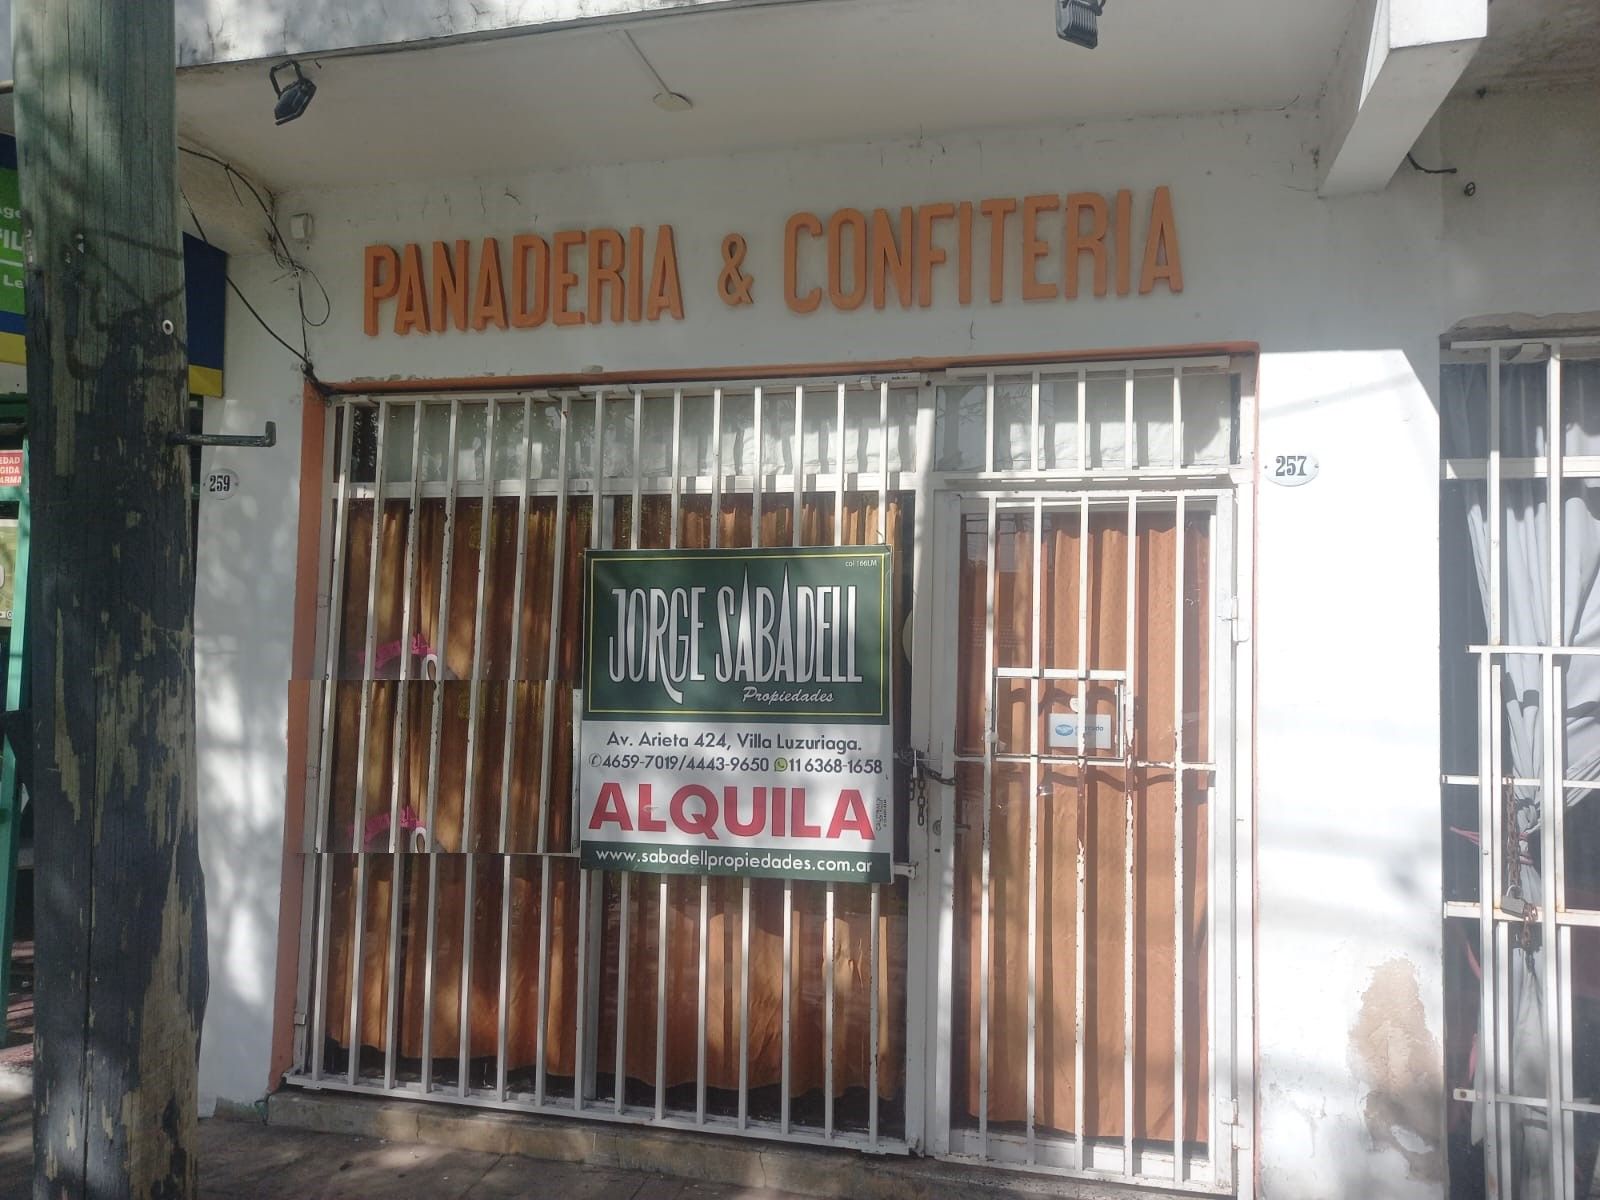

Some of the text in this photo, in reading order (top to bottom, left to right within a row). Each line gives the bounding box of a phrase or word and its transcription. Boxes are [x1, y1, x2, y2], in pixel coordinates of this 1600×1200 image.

[364, 185, 1183, 336] PANADERIA & CONFITERIA
[1275, 455, 1307, 477] 257
[209, 475, 230, 492] 259
[609, 560, 864, 705] JORGE SABADELL
[742, 686, 834, 705] Propiedades
[606, 731, 862, 755] Av. Arieta 424, Villa Luzuriaga.
[588, 782, 876, 841] ALQUILA
[595, 847, 873, 873] www.sabadellpropiedades.com.ar
